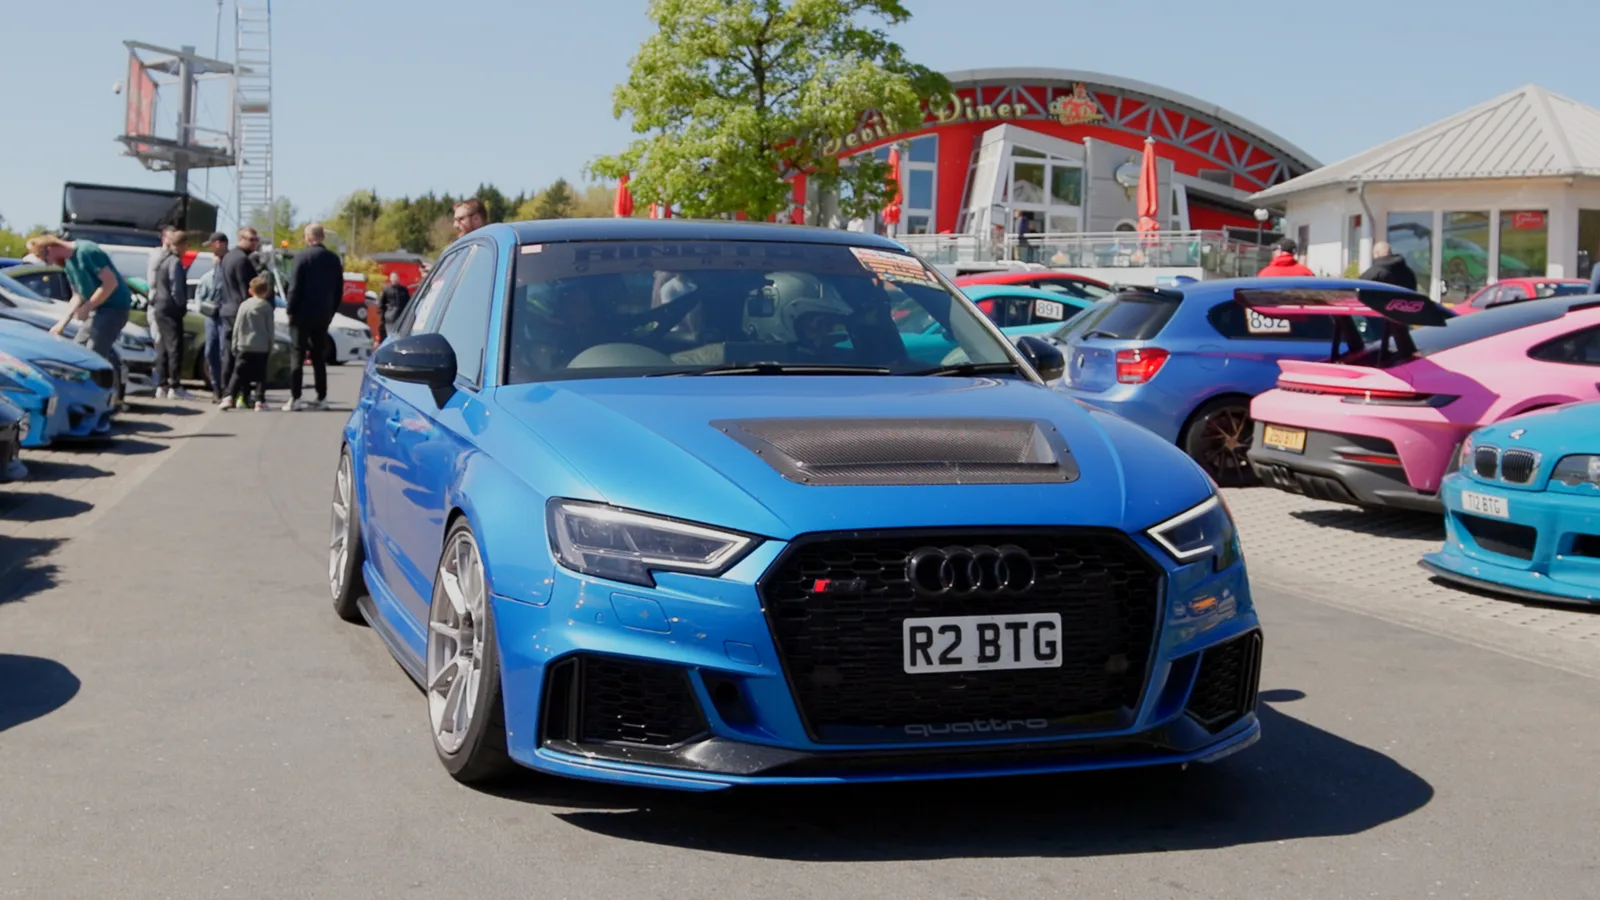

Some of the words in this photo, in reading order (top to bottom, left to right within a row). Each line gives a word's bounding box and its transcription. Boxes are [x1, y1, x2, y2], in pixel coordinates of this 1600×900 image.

[928, 91, 1027, 123] Diner
[1037, 302, 1060, 318] 891
[1482, 496, 1501, 515] BTG
[909, 624, 963, 667] R2
[976, 620, 1057, 664] BTG
[904, 718, 1048, 737] quattro
